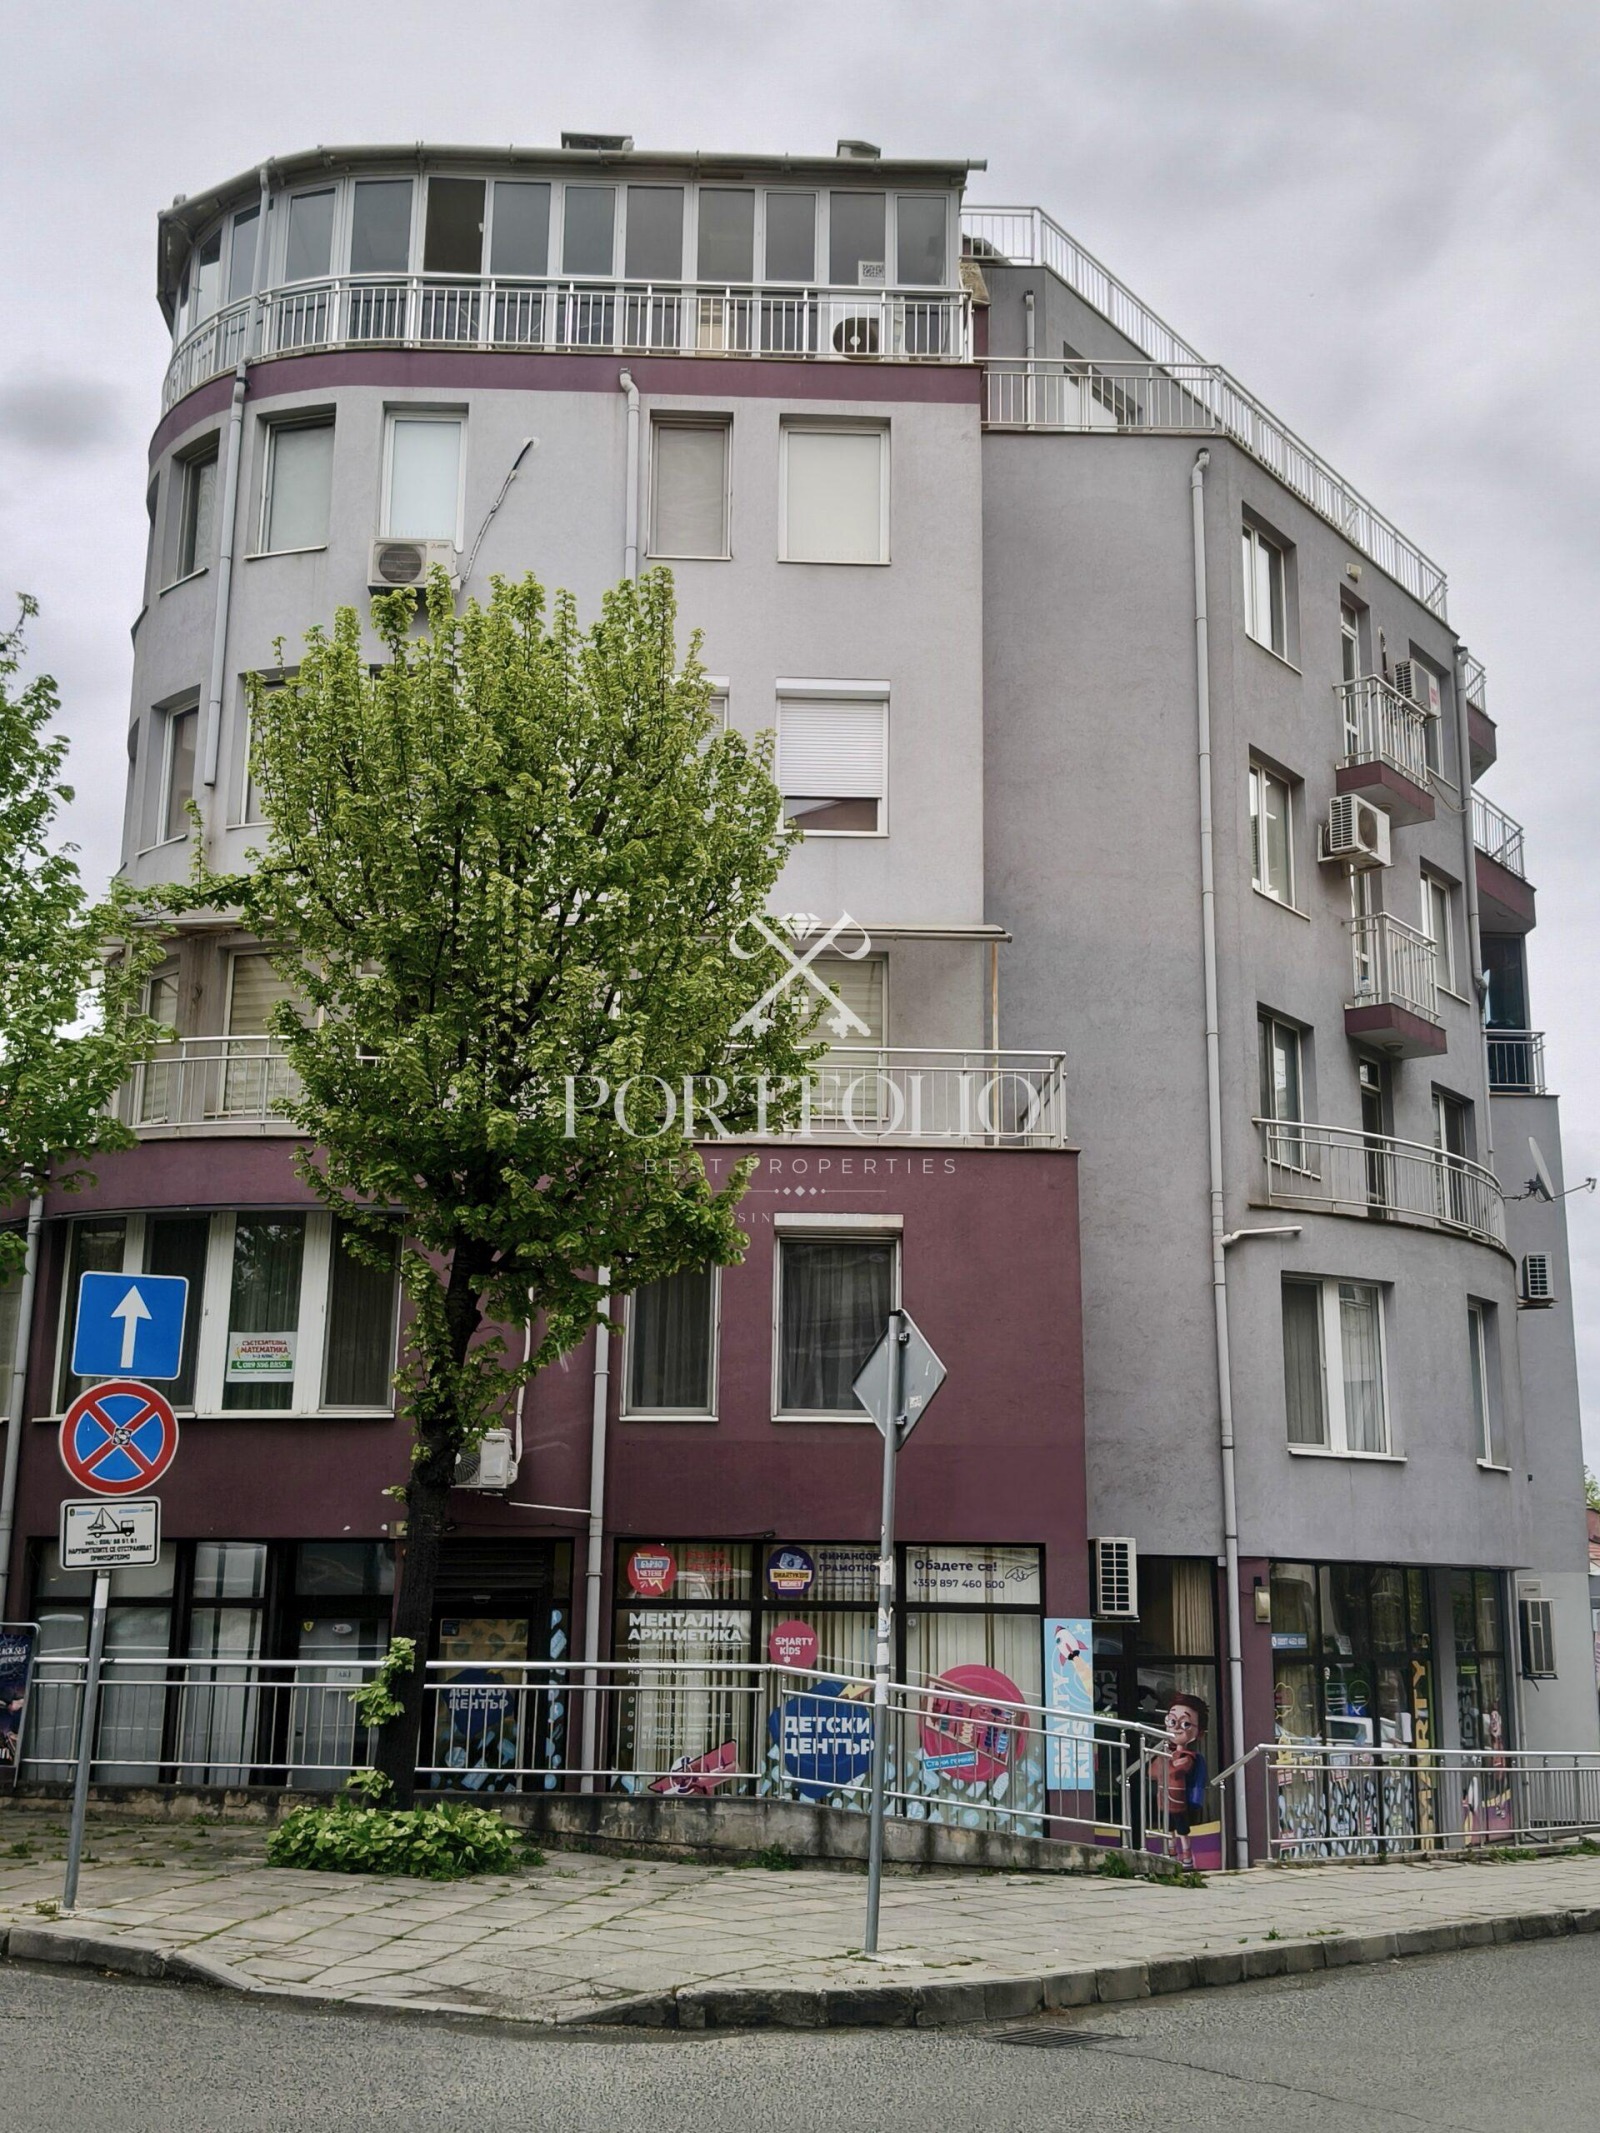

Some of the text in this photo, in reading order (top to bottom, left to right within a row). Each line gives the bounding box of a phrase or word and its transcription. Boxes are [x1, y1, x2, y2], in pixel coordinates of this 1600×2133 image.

[818, 1552, 881, 1561] ФИНАНСОВ
[818, 1564, 880, 1572] ГРАМОТНО
[914, 1560, 998, 1572] Обадете се!
[912, 1578, 1006, 1589] +359 897 460 600
[629, 1612, 741, 1627] МЕНТАЛНА
[628, 1628, 742, 1641] АРИТМЕТИКА
[775, 1637, 814, 1646] SMARTY
[779, 1646, 801, 1655] KIDS
[449, 1688, 507, 1698] ДЕТСКИ
[449, 1699, 509, 1711] ЦЕНТЪР
[784, 1715, 870, 1736] ДЕТСКИ
[784, 1737, 875, 1757] ЦЕНТЪР
